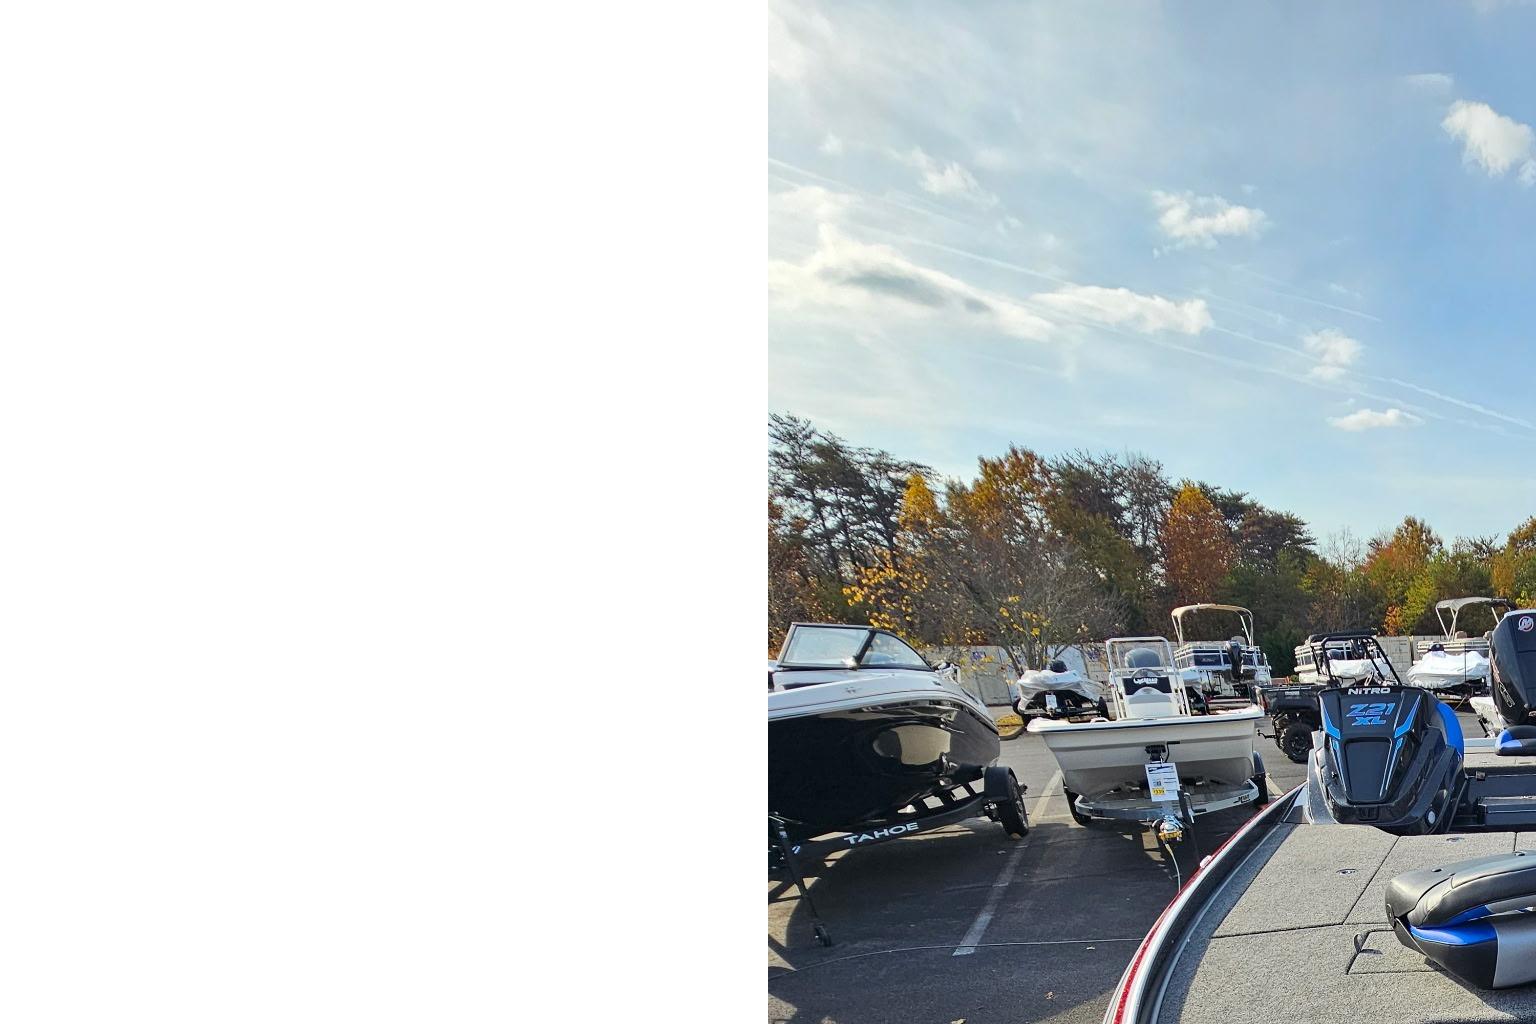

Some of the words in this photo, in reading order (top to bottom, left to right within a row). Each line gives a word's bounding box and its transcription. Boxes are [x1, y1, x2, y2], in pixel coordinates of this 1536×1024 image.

[1347, 687, 1391, 695] NITRO
[1346, 702, 1396, 717] Z21
[1351, 715, 1387, 726] XL
[843, 822, 920, 845] TAHOE
